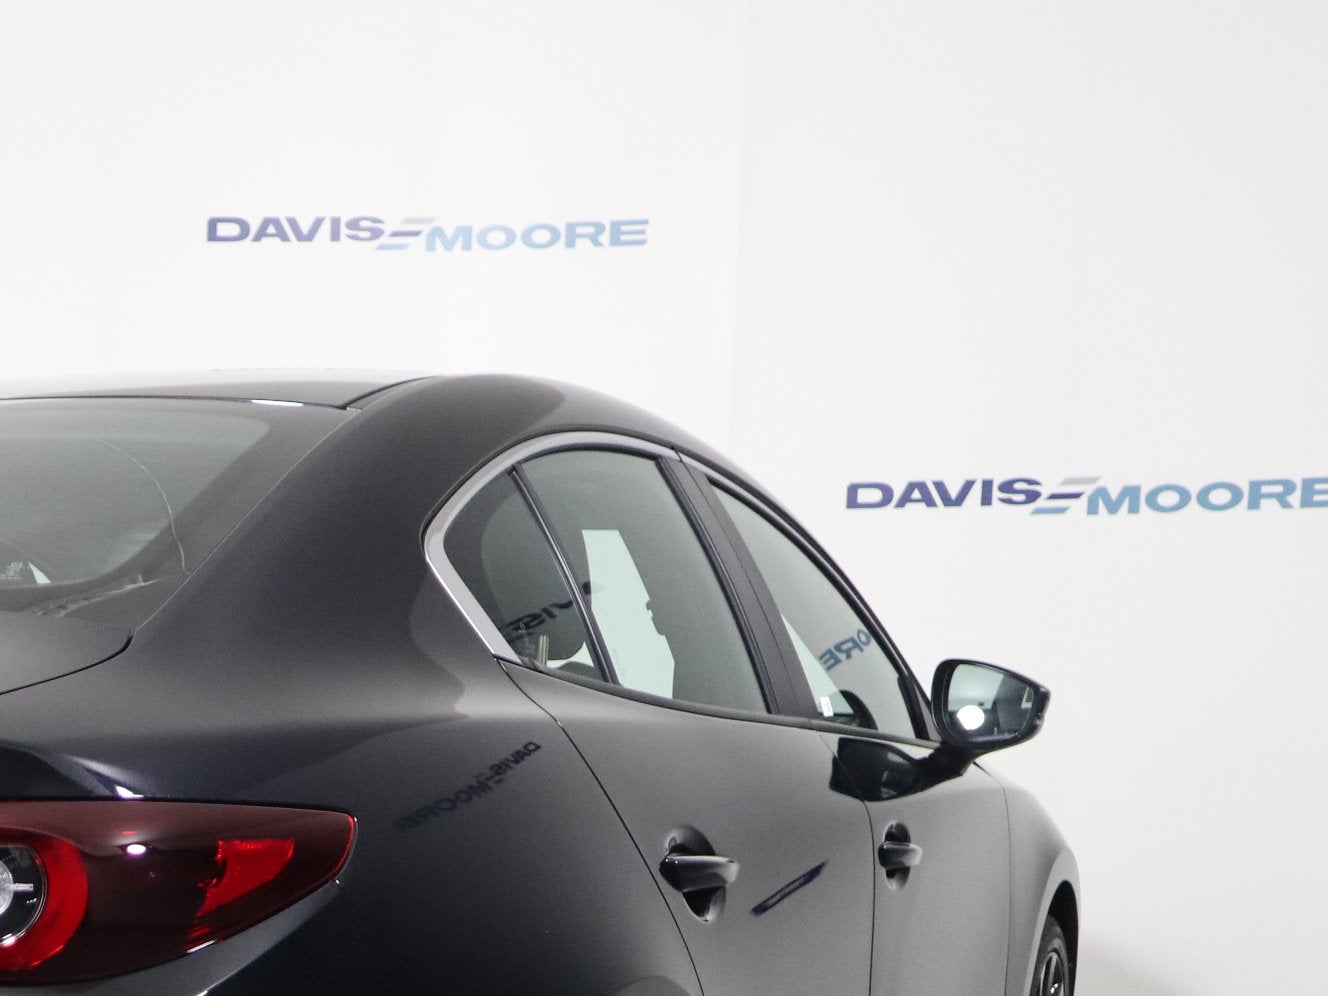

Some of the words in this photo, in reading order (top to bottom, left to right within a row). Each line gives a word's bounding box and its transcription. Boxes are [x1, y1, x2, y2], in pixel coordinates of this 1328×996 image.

[206, 215, 386, 243] DAVIS
[425, 218, 650, 252] MOORE
[845, 477, 1042, 509] DAVIS
[1085, 476, 1328, 515] MOORE
